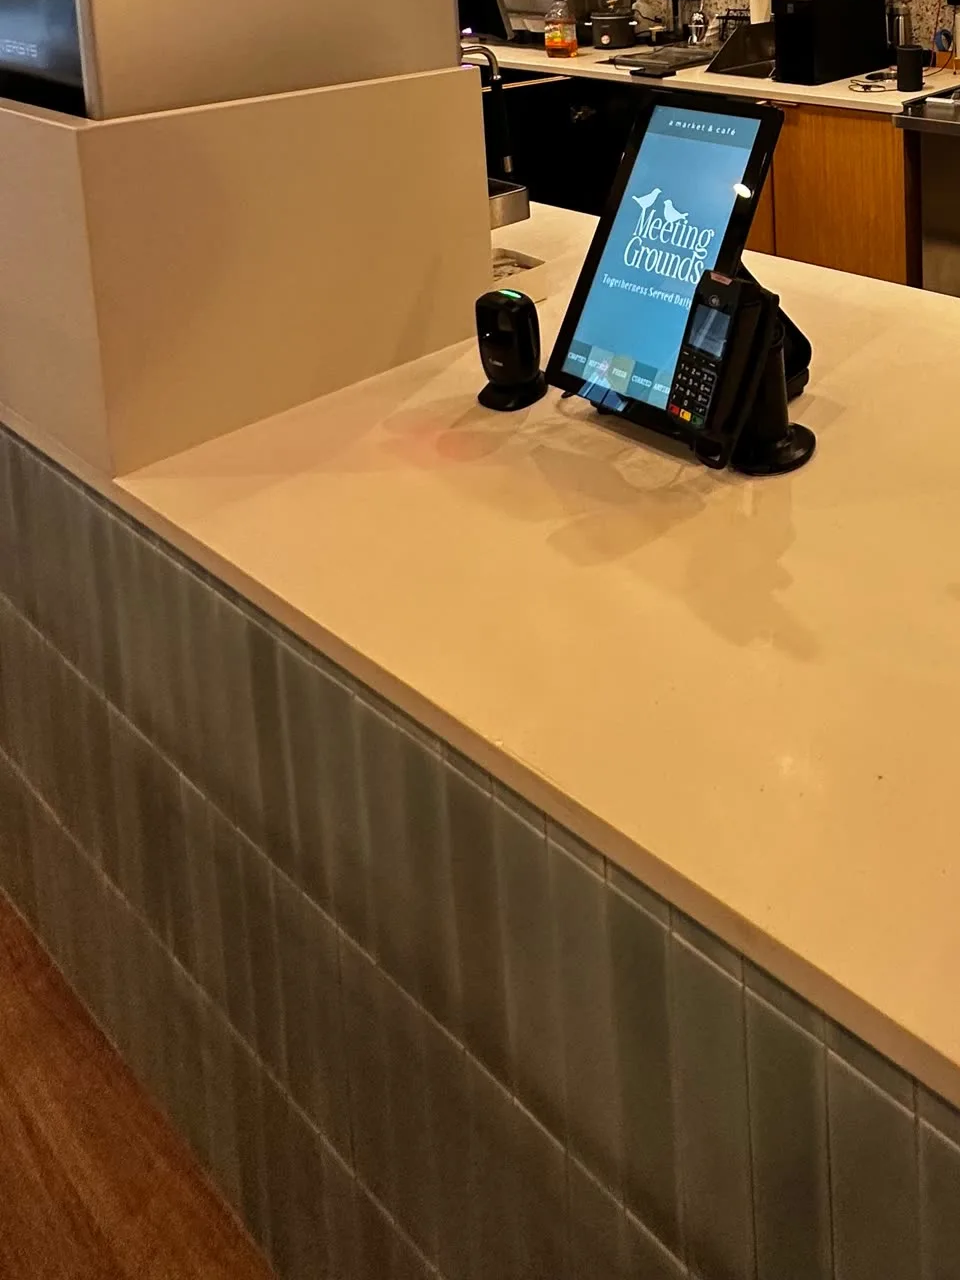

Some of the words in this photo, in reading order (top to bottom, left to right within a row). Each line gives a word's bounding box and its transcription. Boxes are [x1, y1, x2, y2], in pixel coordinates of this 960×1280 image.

[675, 121, 705, 131] market
[716, 126, 736, 136] café
[633, 208, 714, 259] Meeting
[624, 236, 704, 284] Grounds
[603, 273, 648, 296] Togetherness
[649, 286, 673, 303] Served
